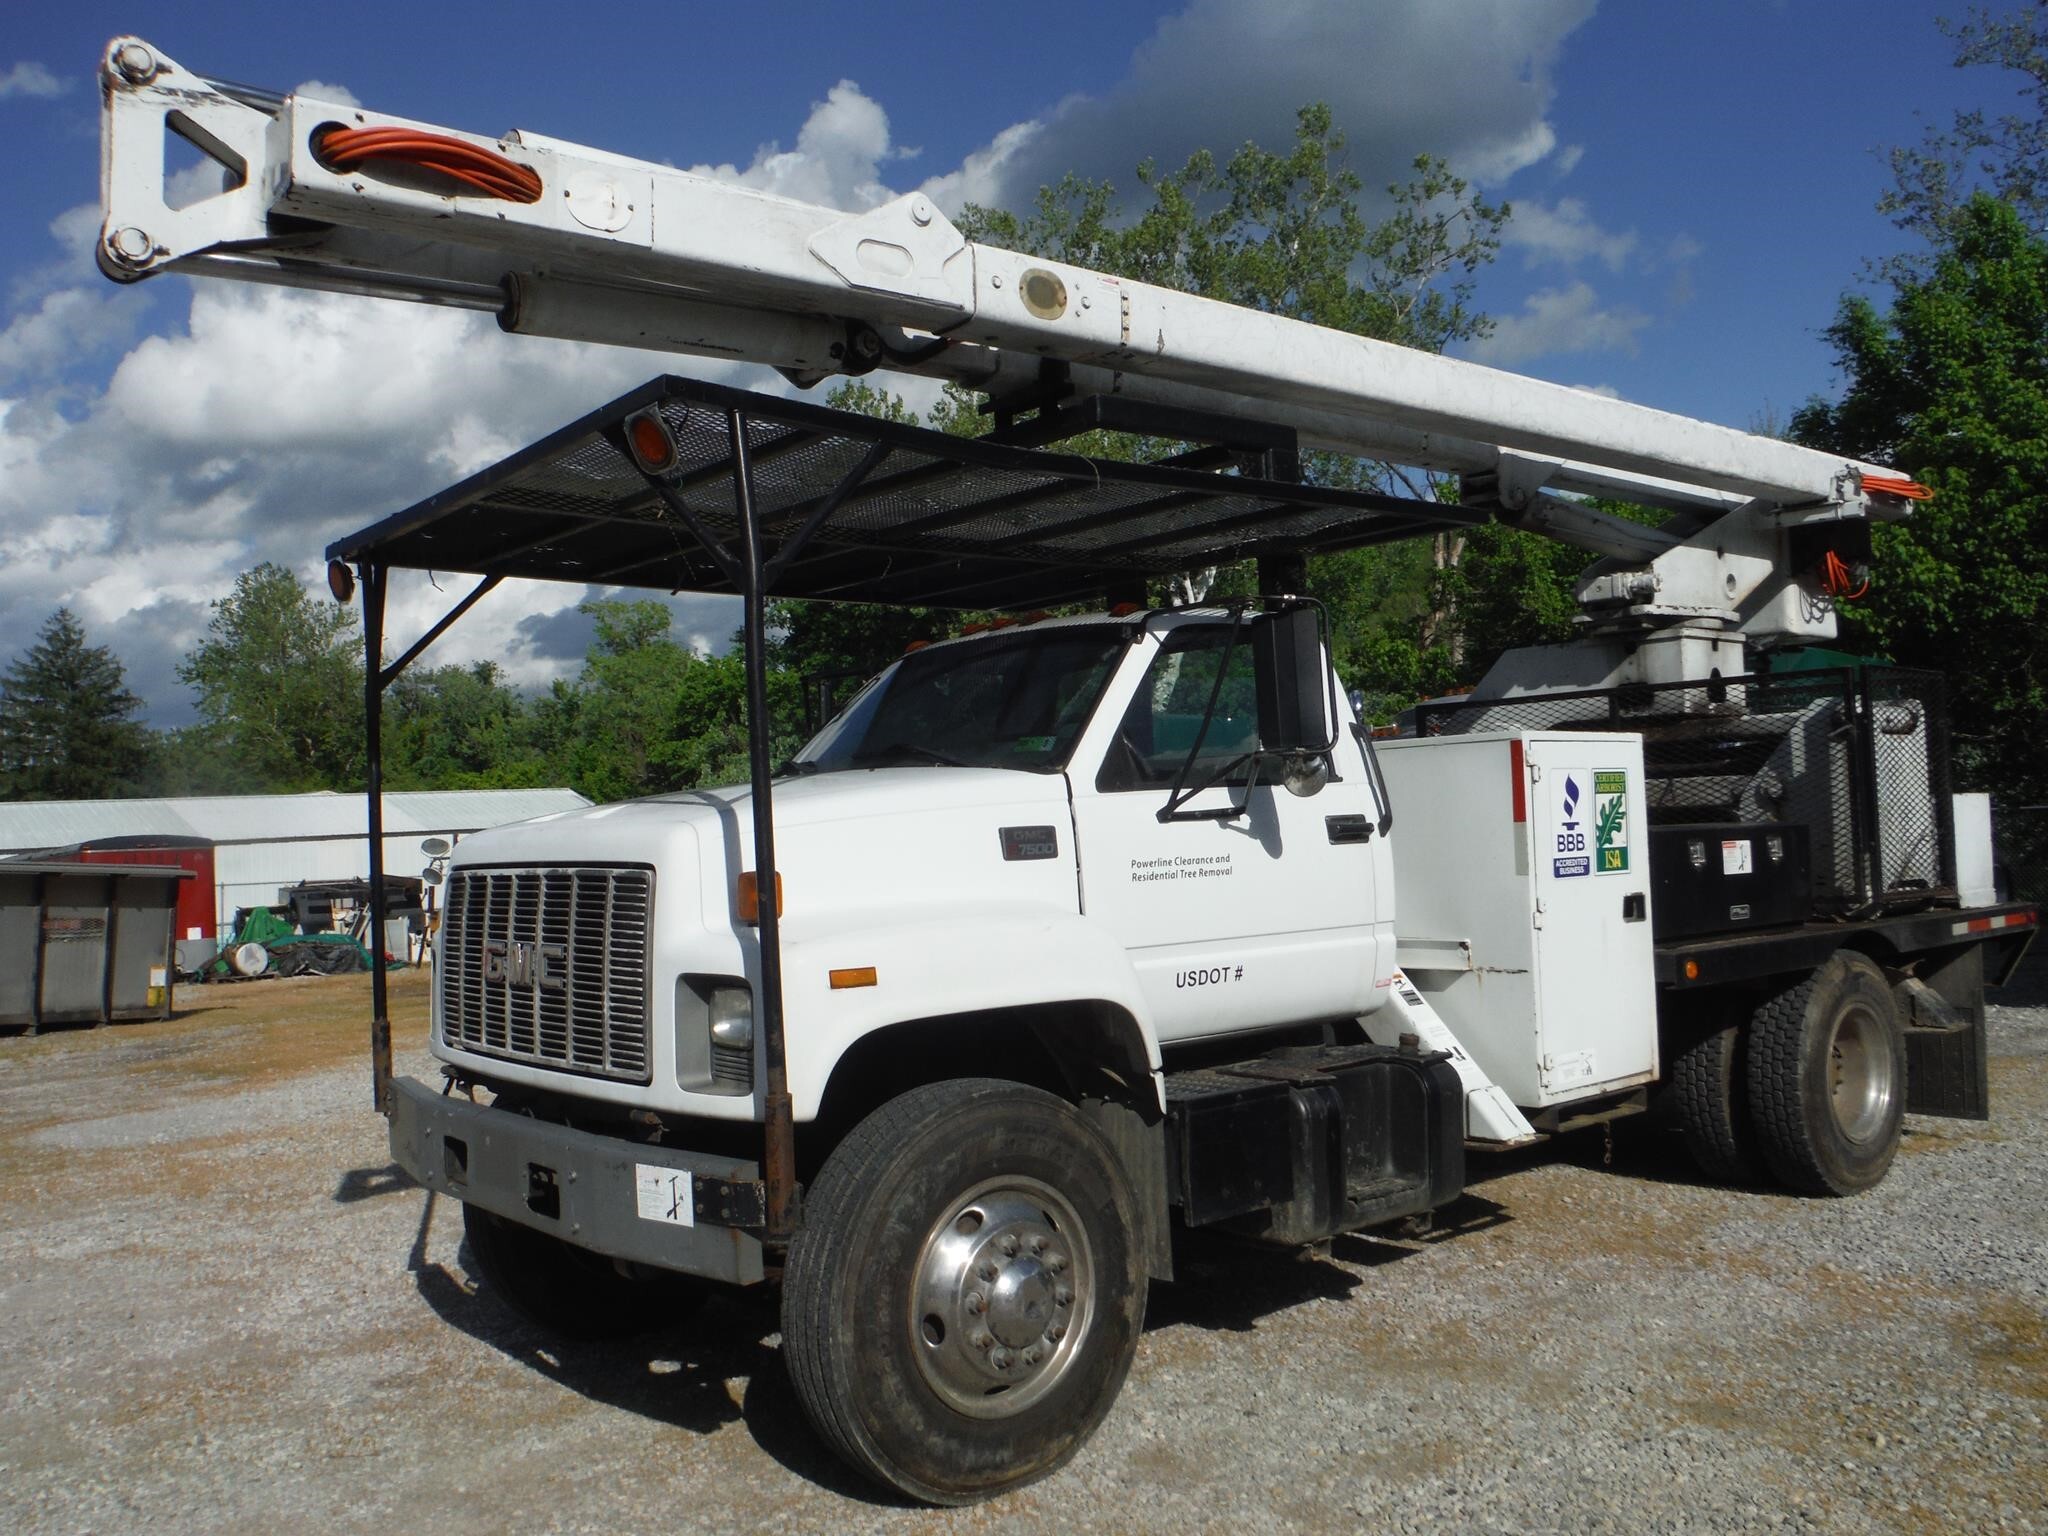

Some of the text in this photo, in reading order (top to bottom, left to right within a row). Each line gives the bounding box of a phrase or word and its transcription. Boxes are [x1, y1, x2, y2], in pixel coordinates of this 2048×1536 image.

[1557, 833, 1585, 852] BBB
[1131, 853, 1231, 869] Powerline Clearance and
[1556, 858, 1588, 867] ACCREDITED
[1606, 850, 1621, 868] ISA
[1131, 866, 1233, 882] Residential Tree Removal
[1559, 866, 1585, 875] BUSINESS
[484, 940, 565, 989] GMC
[1176, 965, 1244, 989] USDOT #
